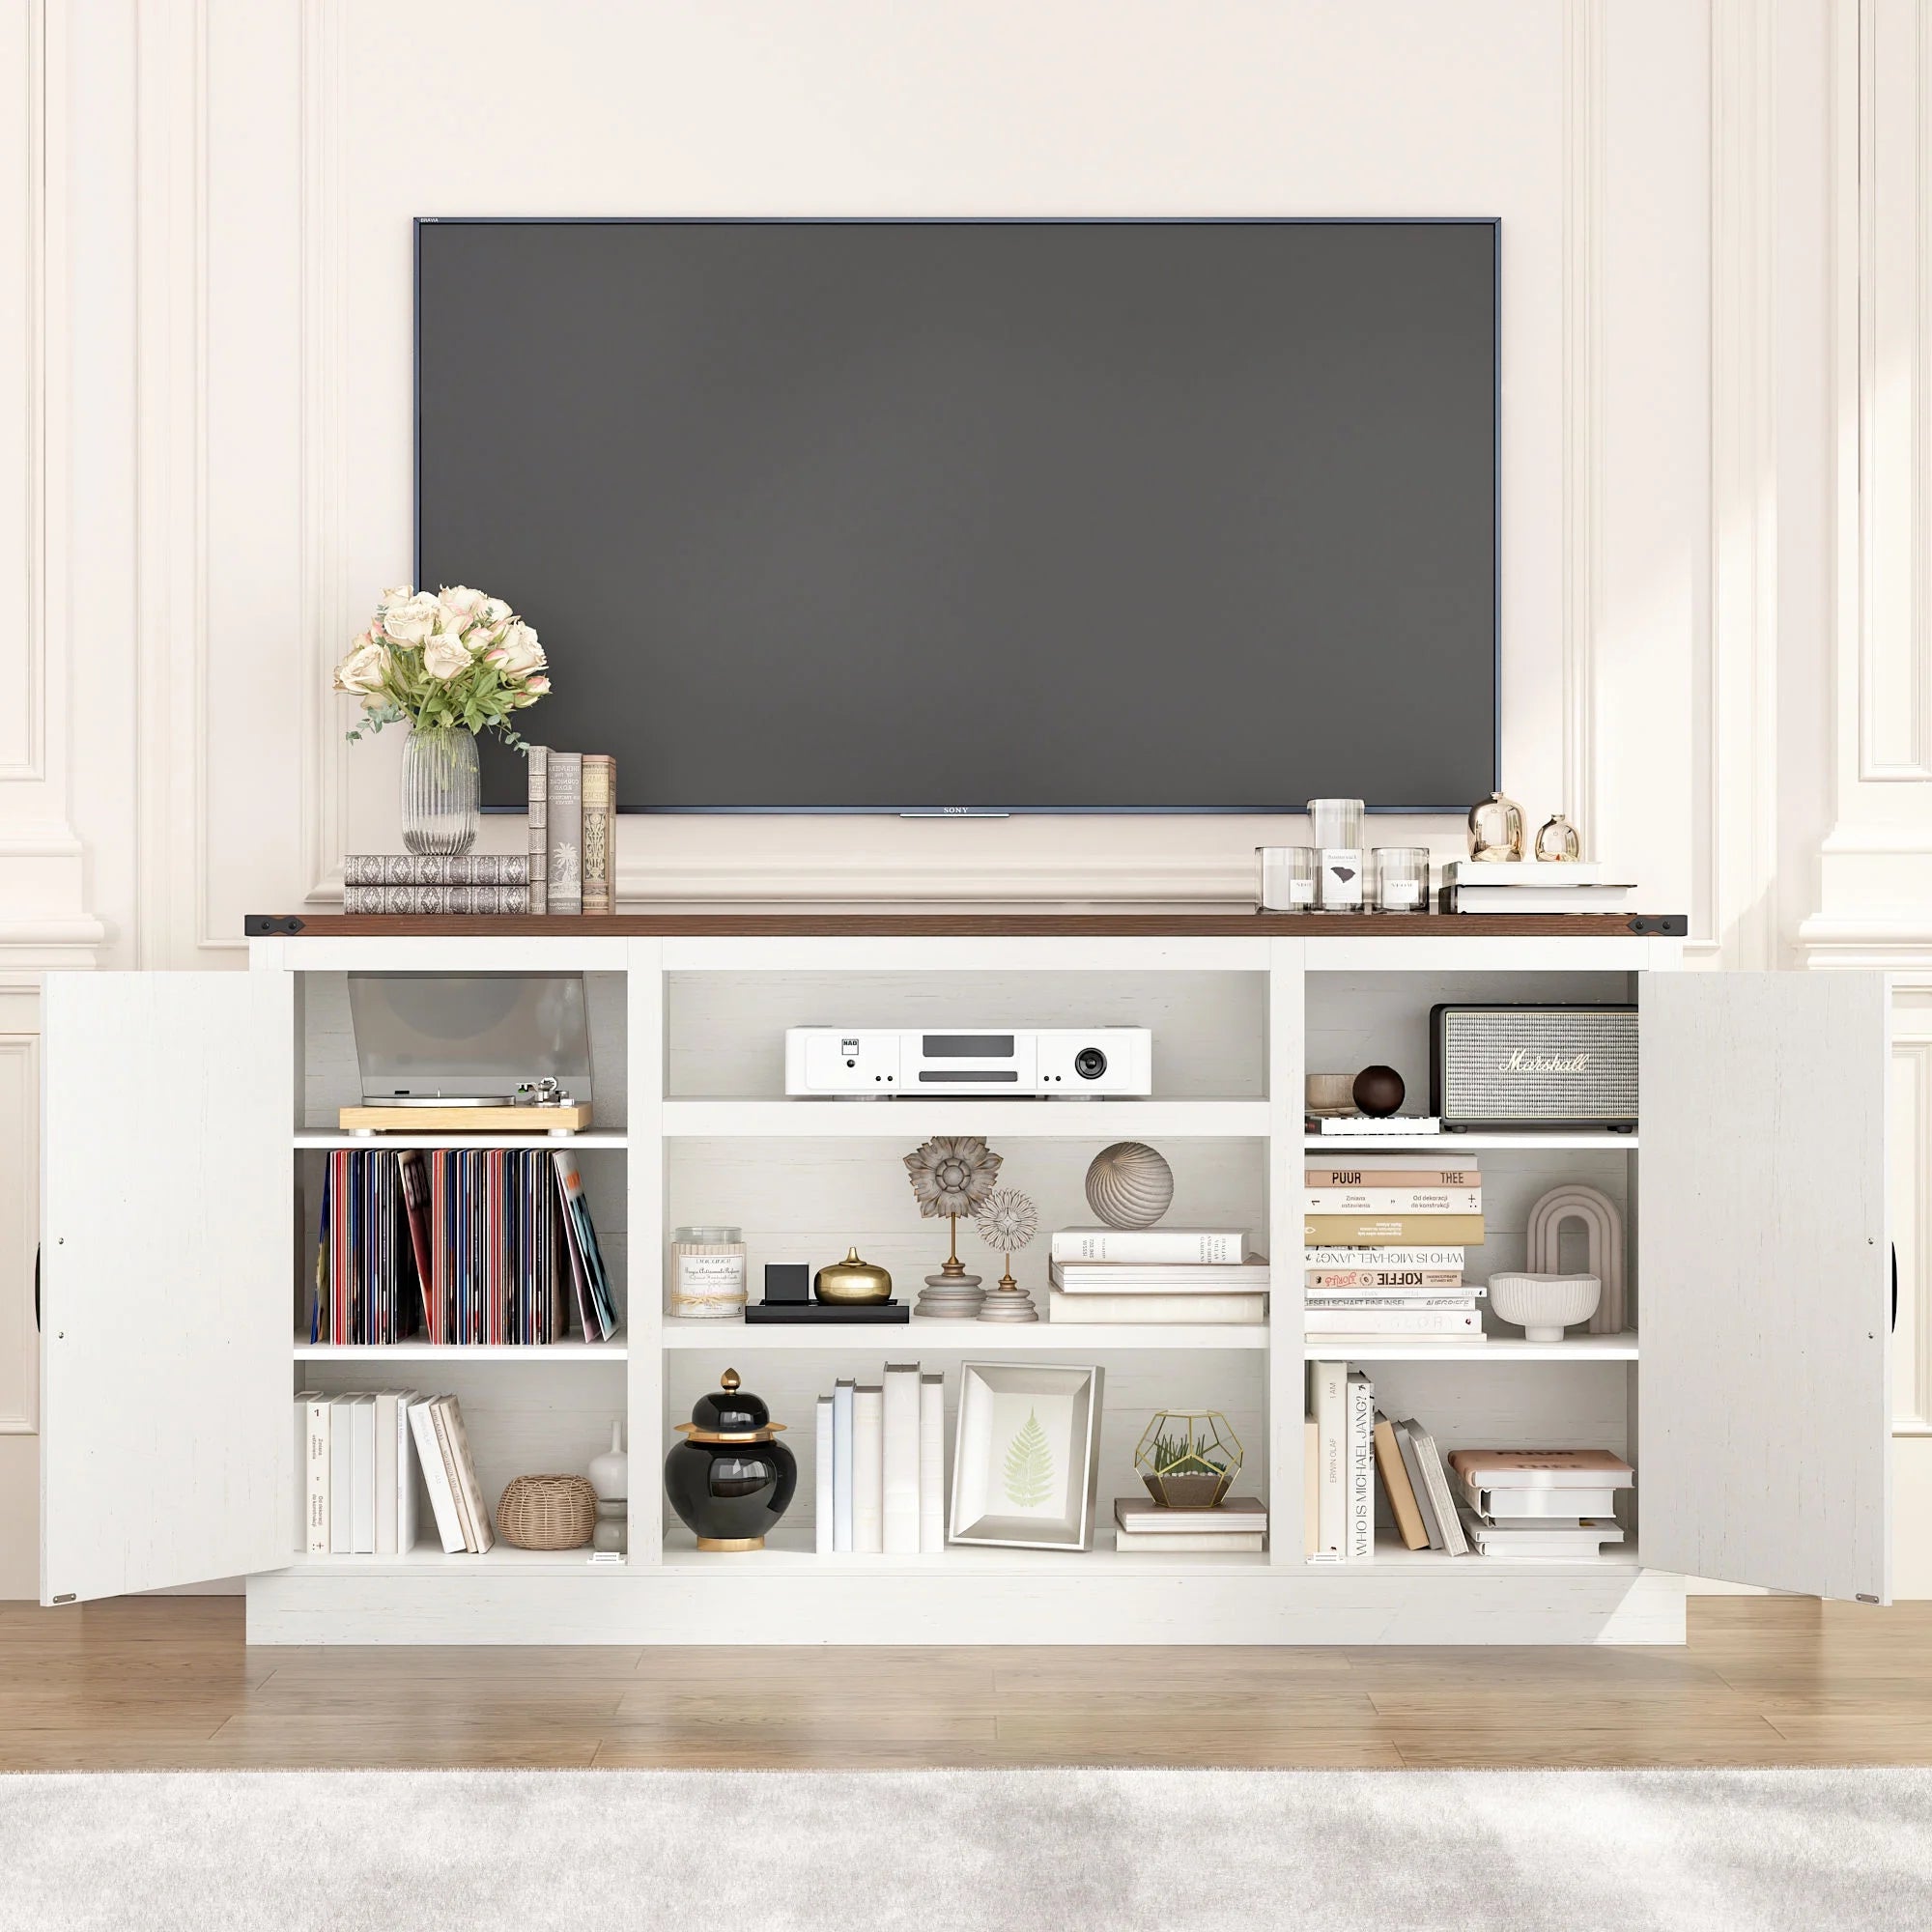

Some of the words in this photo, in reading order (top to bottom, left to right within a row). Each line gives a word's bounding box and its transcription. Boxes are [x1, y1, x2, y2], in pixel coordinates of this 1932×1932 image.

[1498, 1047, 1589, 1072] Marshall
[1332, 1172, 1361, 1184] PUUR
[1440, 1172, 1464, 1184] THEE
[1316, 1252, 1356, 1264] JANG?
[1360, 1252, 1414, 1264] MICHAEL
[1417, 1252, 1428, 1264] IS
[1430, 1252, 1463, 1264] WHO
[1378, 1272, 1423, 1285] KOFFIE
[1355, 1396, 1367, 1439] JANG?
[1355, 1441, 1367, 1502] MICHAEL
[1355, 1506, 1367, 1518] IS
[1355, 1520, 1367, 1556] WHO
